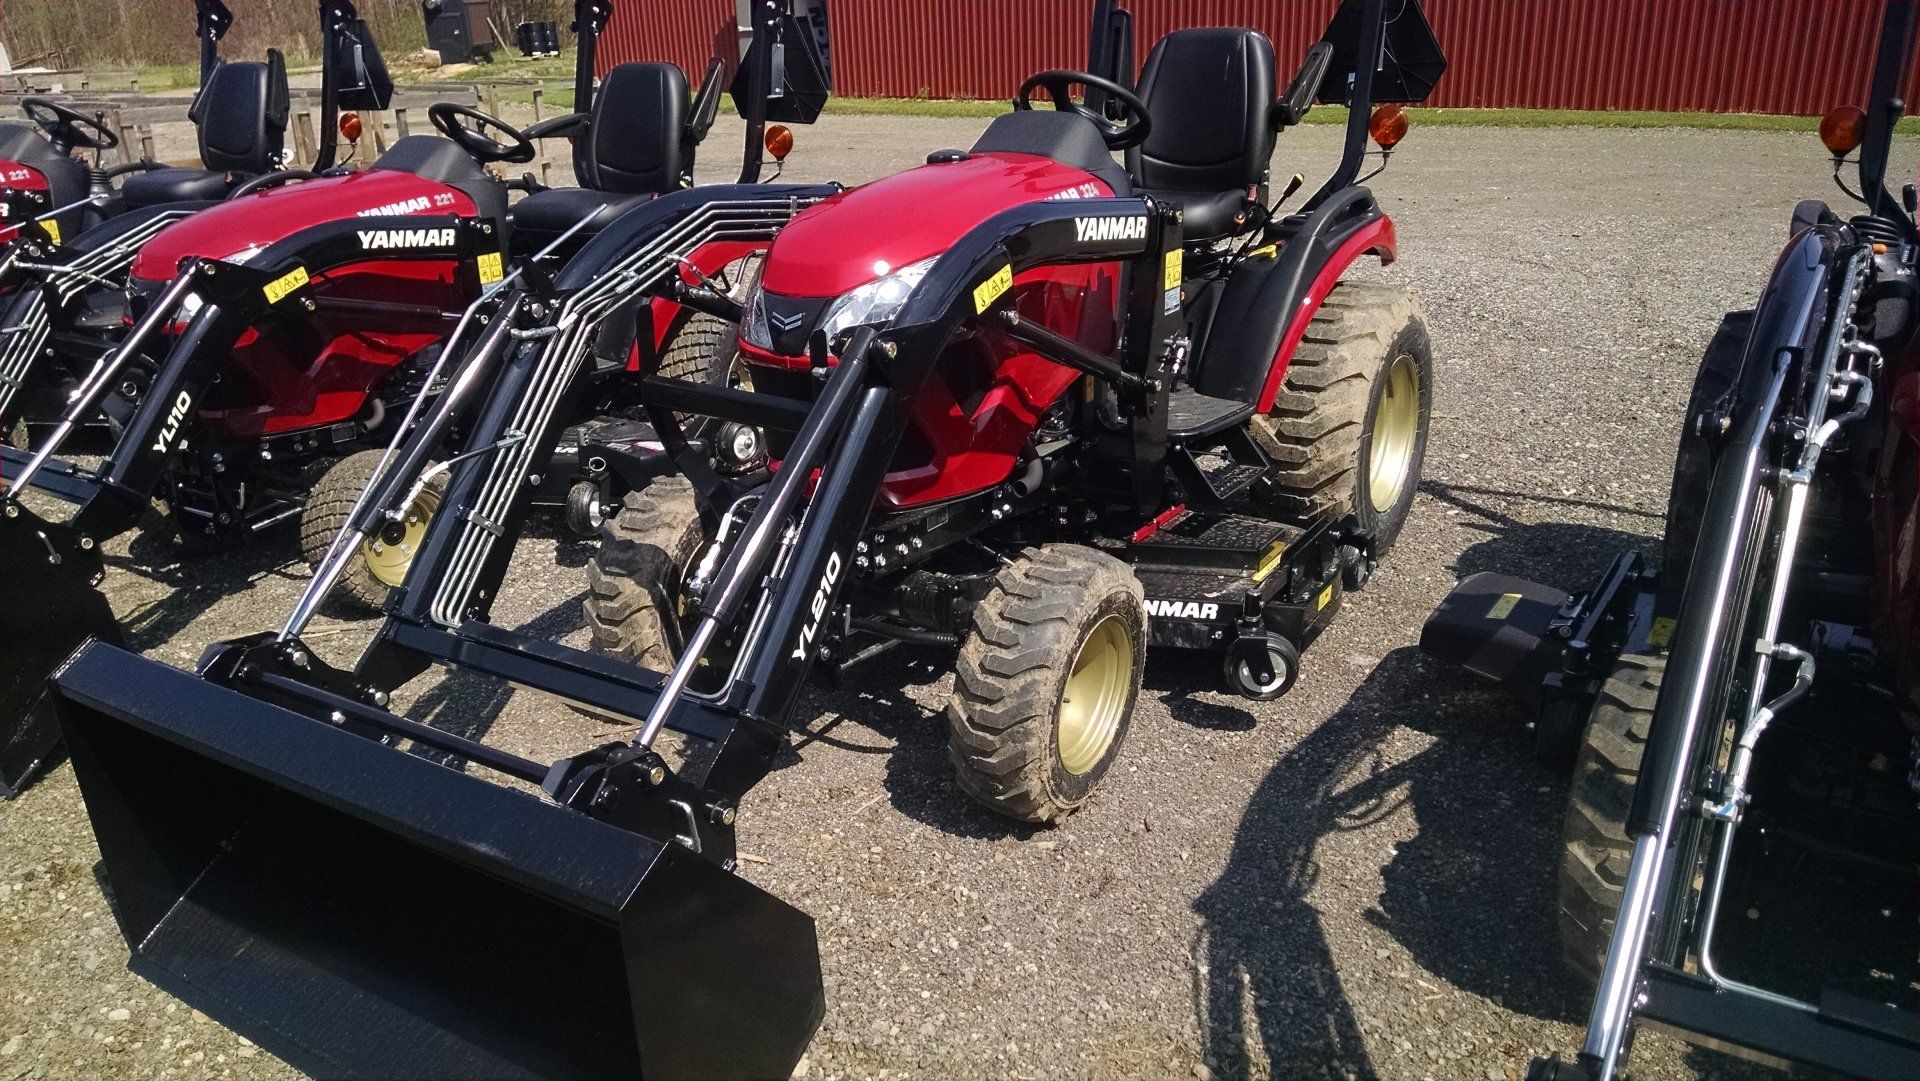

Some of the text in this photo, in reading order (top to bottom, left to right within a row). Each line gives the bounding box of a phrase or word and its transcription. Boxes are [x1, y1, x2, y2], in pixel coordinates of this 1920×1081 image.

[8, 169, 31, 181] 221
[434, 193, 455, 206] 221
[1075, 216, 1148, 241] YANMAR
[357, 229, 456, 249] YANMAR
[152, 391, 191, 453] YL110
[791, 551, 840, 661] YL210
[1142, 599, 1219, 619] NMAR
